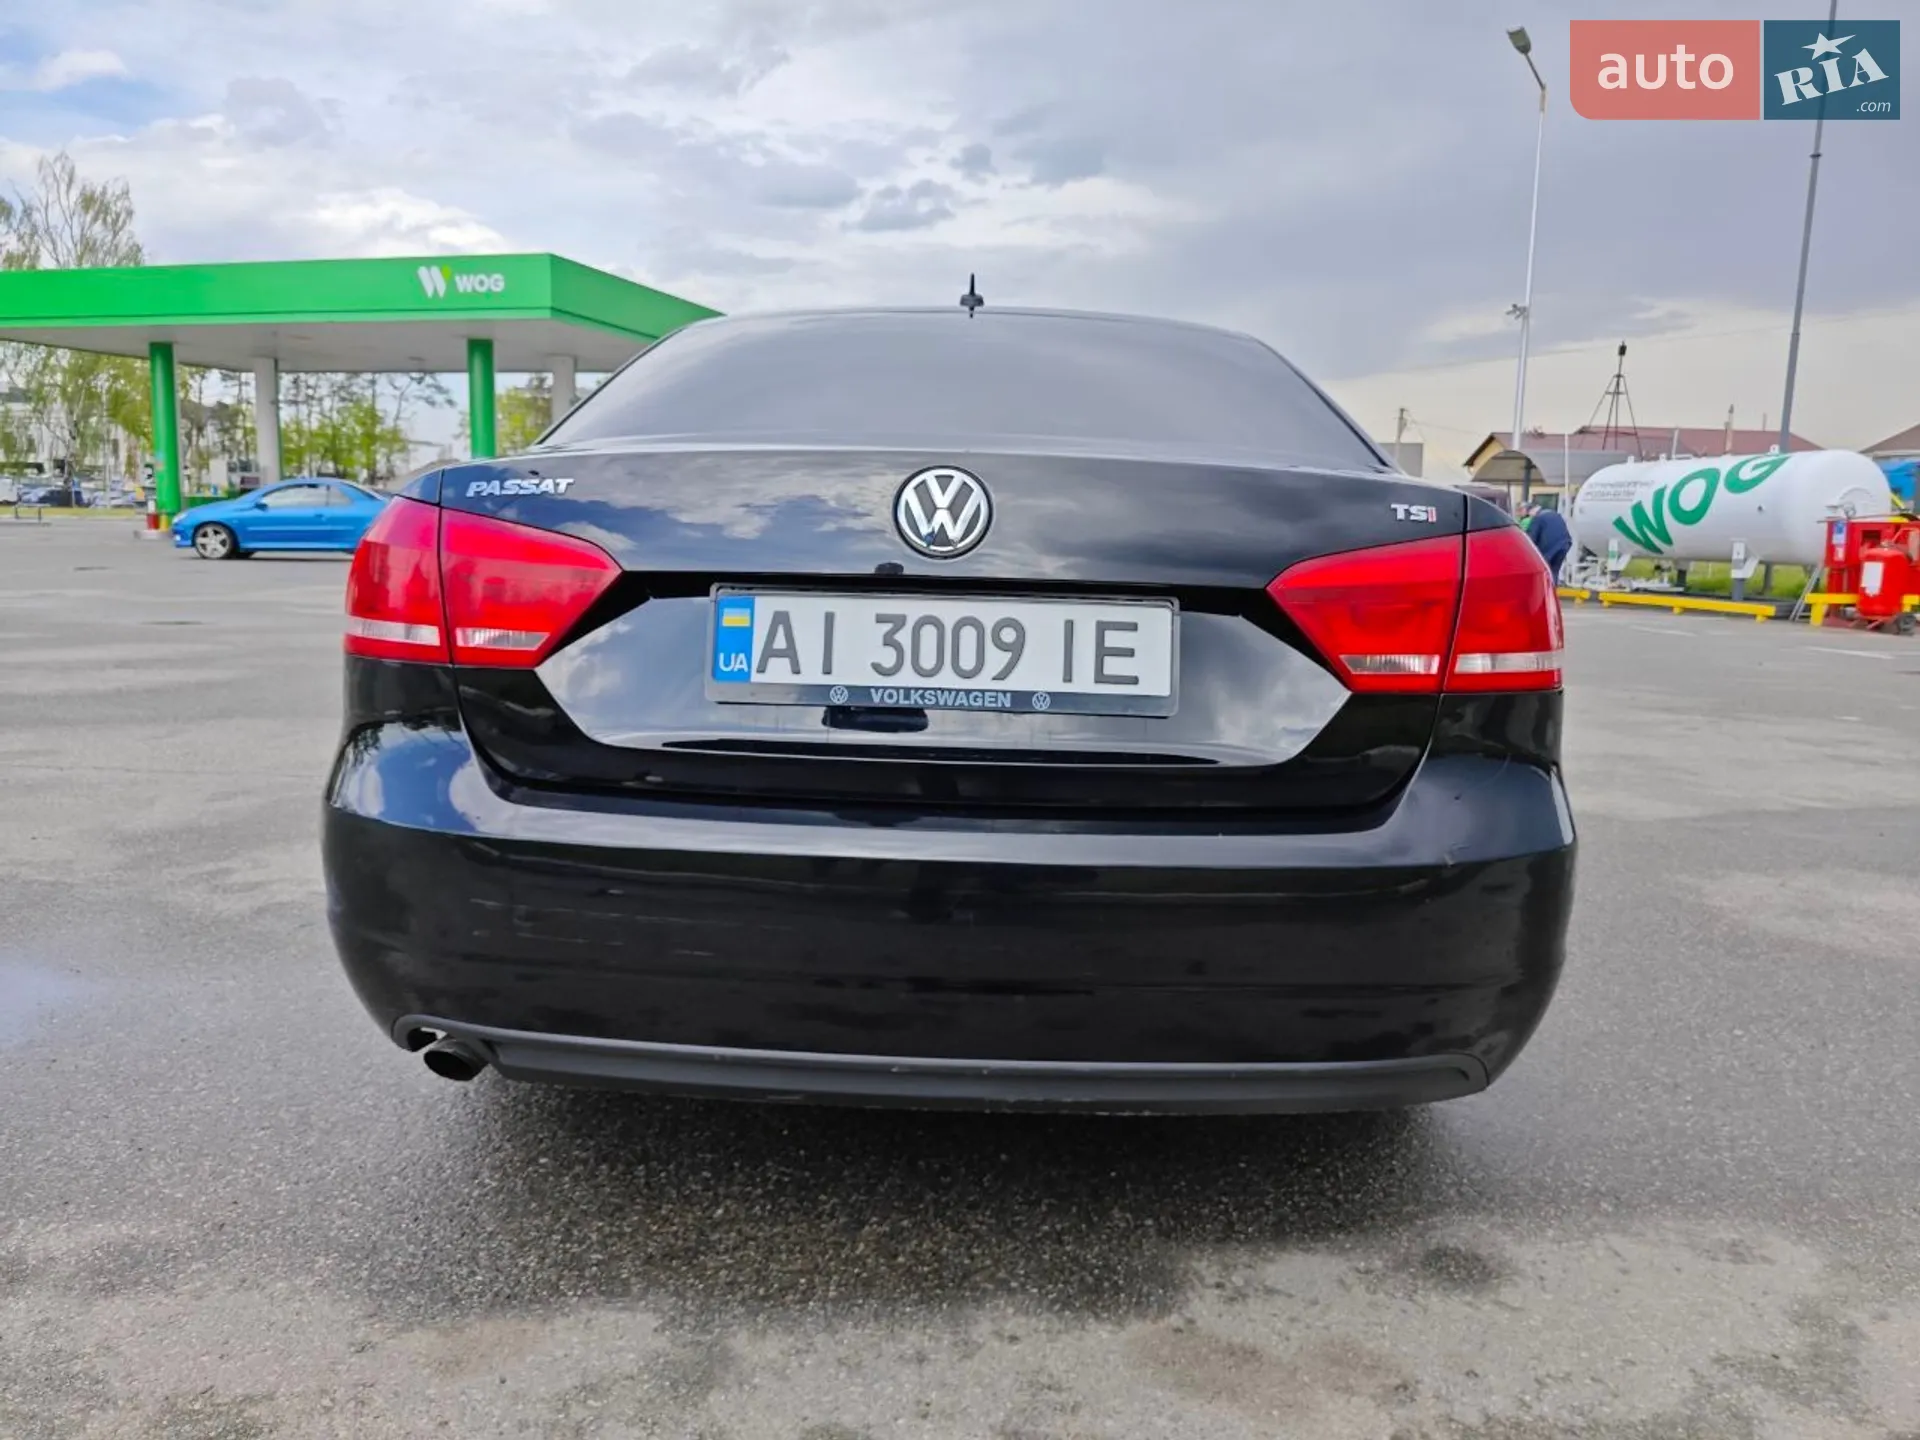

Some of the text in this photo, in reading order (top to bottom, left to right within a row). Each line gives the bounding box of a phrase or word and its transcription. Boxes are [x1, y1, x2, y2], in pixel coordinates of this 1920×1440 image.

[454, 273, 505, 293] WOG
[465, 478, 575, 498] PASSAT
[1612, 453, 1792, 555] WOG
[756, 610, 1140, 686] AI 3009 IE
[718, 652, 749, 673] UA
[869, 687, 1012, 708] VOLKSWAGEN
